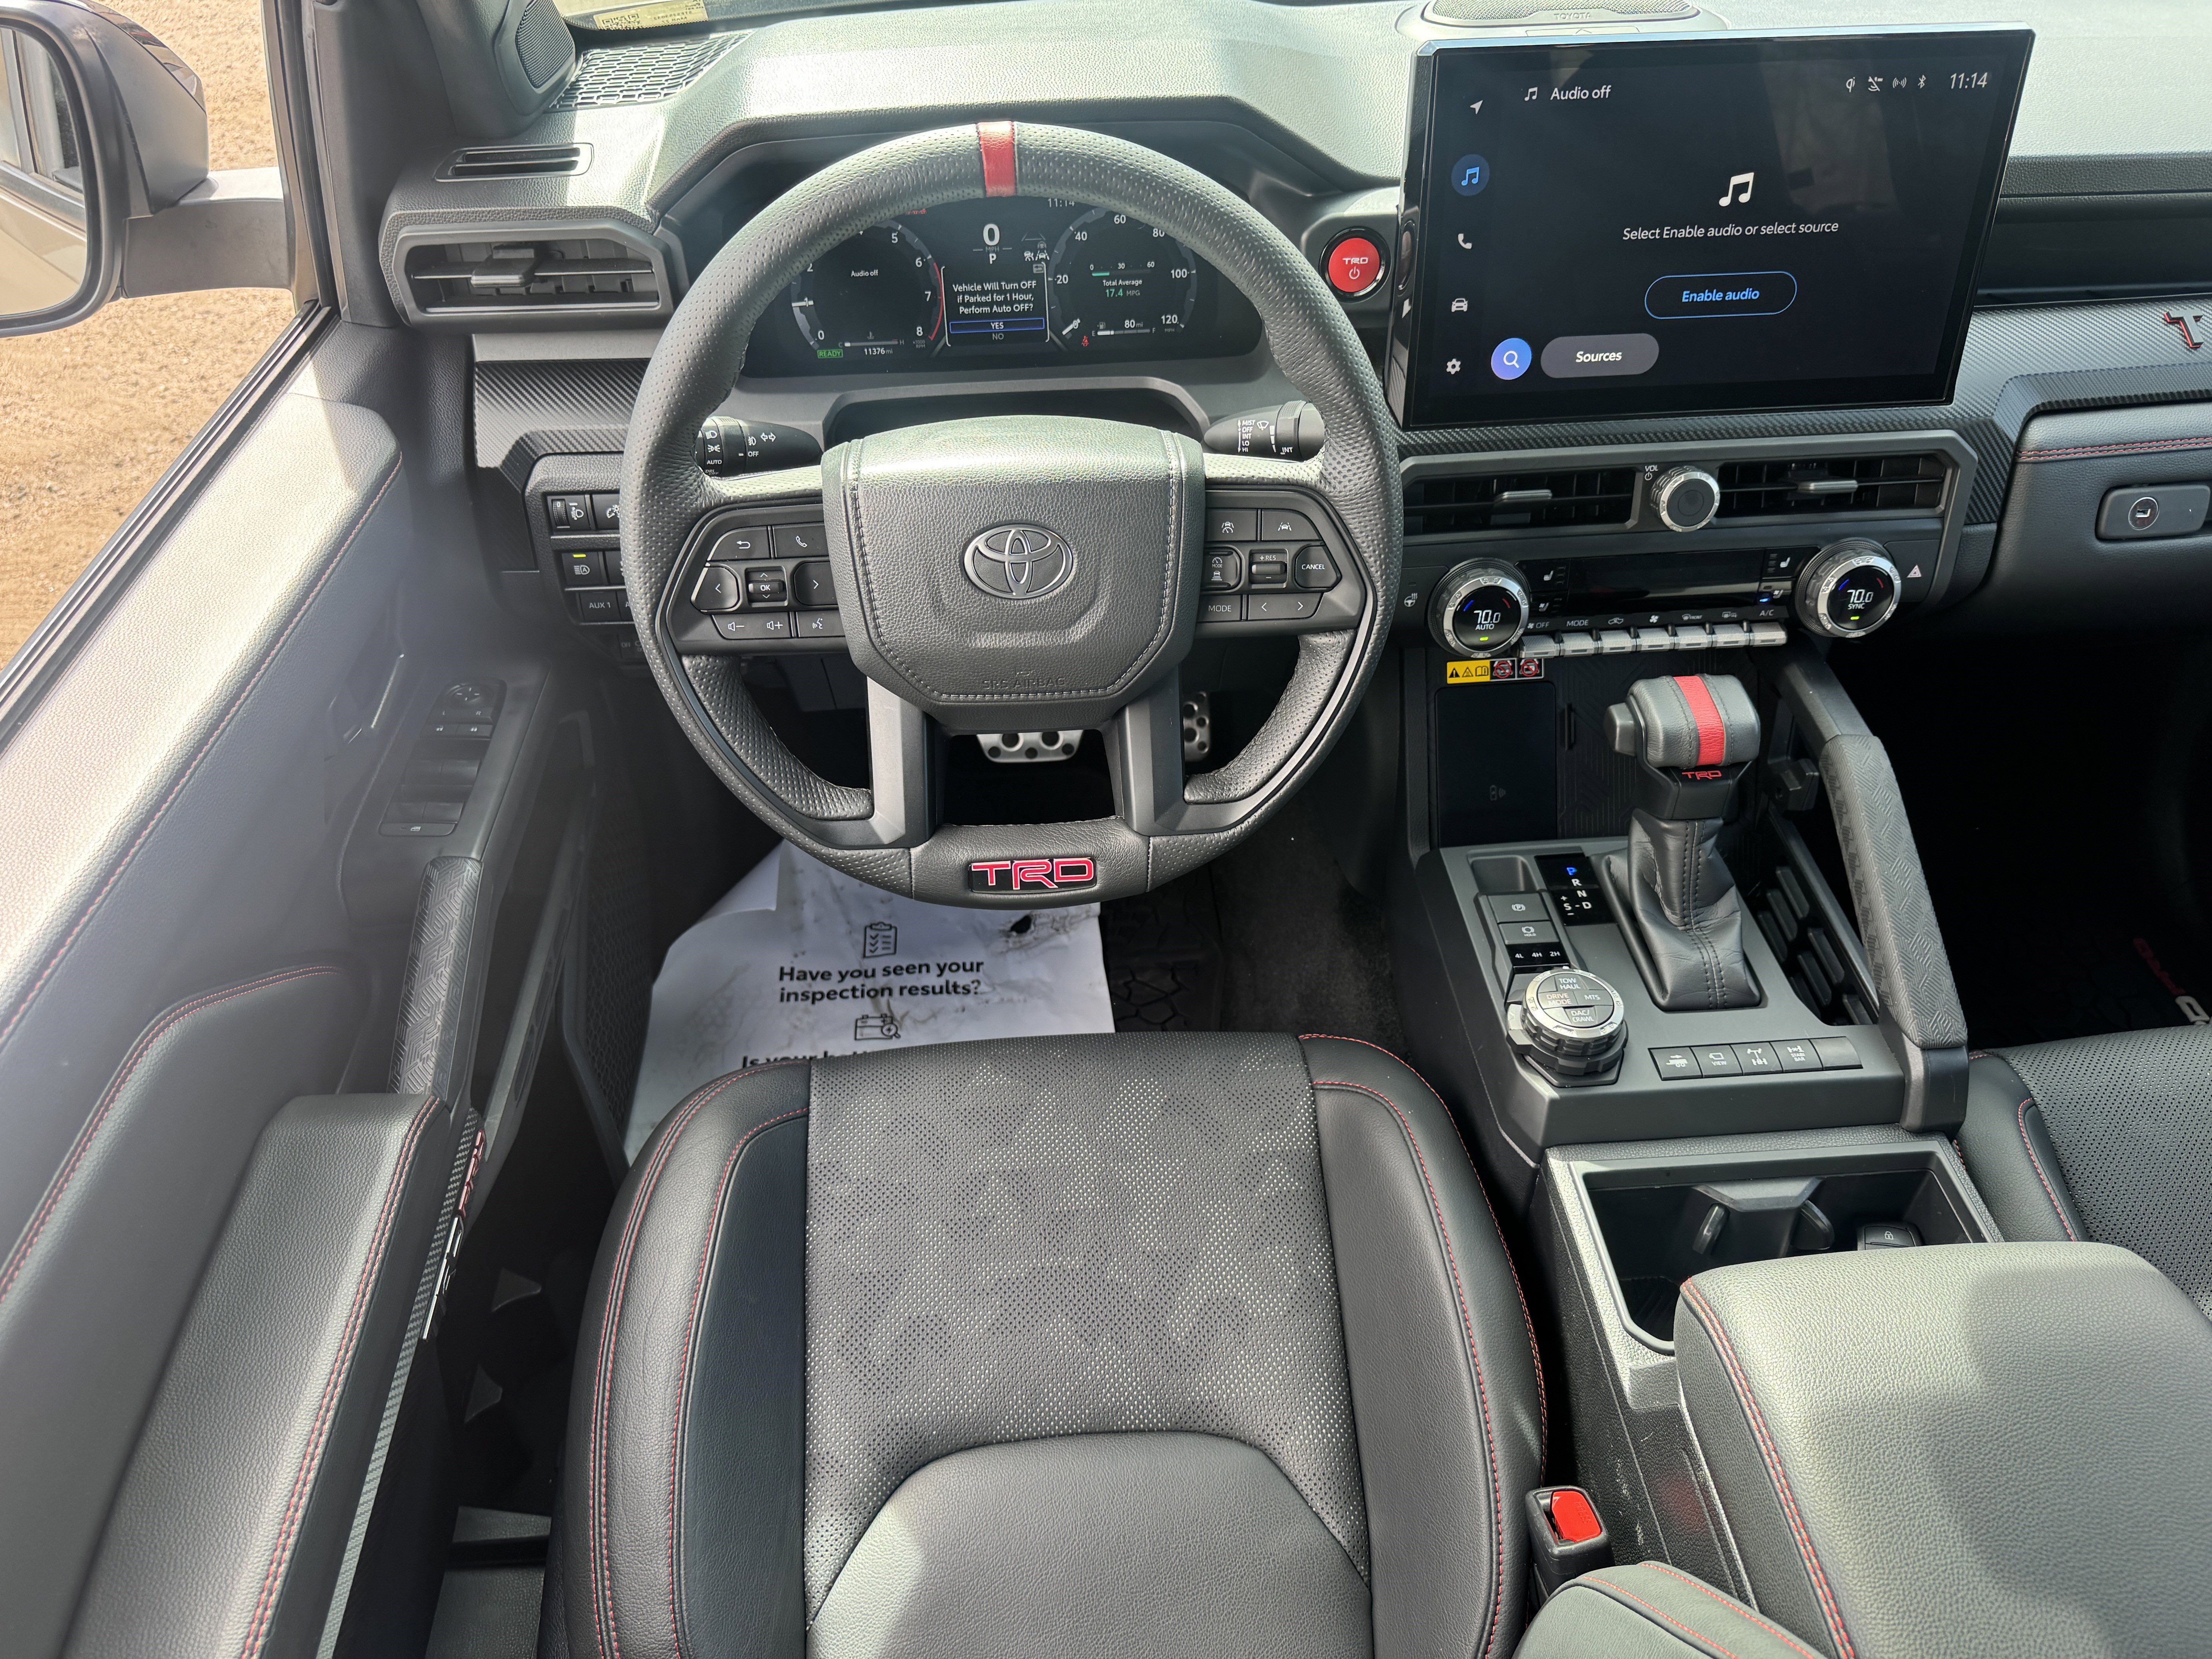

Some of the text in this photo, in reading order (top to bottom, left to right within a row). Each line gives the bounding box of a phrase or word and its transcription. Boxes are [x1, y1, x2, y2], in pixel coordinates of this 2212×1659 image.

[1950, 72, 1987, 89] 11:14
[1550, 85, 1611, 100] Audio off
[1114, 215, 1126, 224] 60
[983, 223, 1000, 246] 0
[1152, 228, 1165, 237] 80
[1623, 222, 1838, 240] Select Enable audio or select source
[891, 233, 898, 243] 5
[1075, 232, 1087, 241] 40
[915, 257, 922, 267] 6
[989, 253, 996, 264] P
[1171, 269, 1187, 278] 100
[1056, 275, 1068, 284] 20
[953, 283, 982, 292] Vehicle
[983, 282, 999, 290] Will
[1020, 281, 1037, 289] OFF
[925, 291, 931, 301] 7
[1105, 288, 1123, 297] 17.4
[1682, 288, 1760, 302] Enable audio
[965, 294, 991, 302] Parked
[1125, 319, 1135, 328] 80
[1161, 314, 1178, 324] 120
[818, 330, 824, 340] 0
[916, 326, 923, 336] 8
[1576, 351, 1622, 362] Sources
[1847, 589, 1874, 603] 70.0
[1474, 610, 1501, 624] 70.0
[983, 678, 1065, 689] SRS AIRBAG
[1682, 770, 1722, 780] TRD
[971, 857, 1094, 890] TRD
[1571, 878, 1582, 886] R
[779, 960, 984, 983] Have you seen your
[780, 979, 982, 1004] inspection results?
